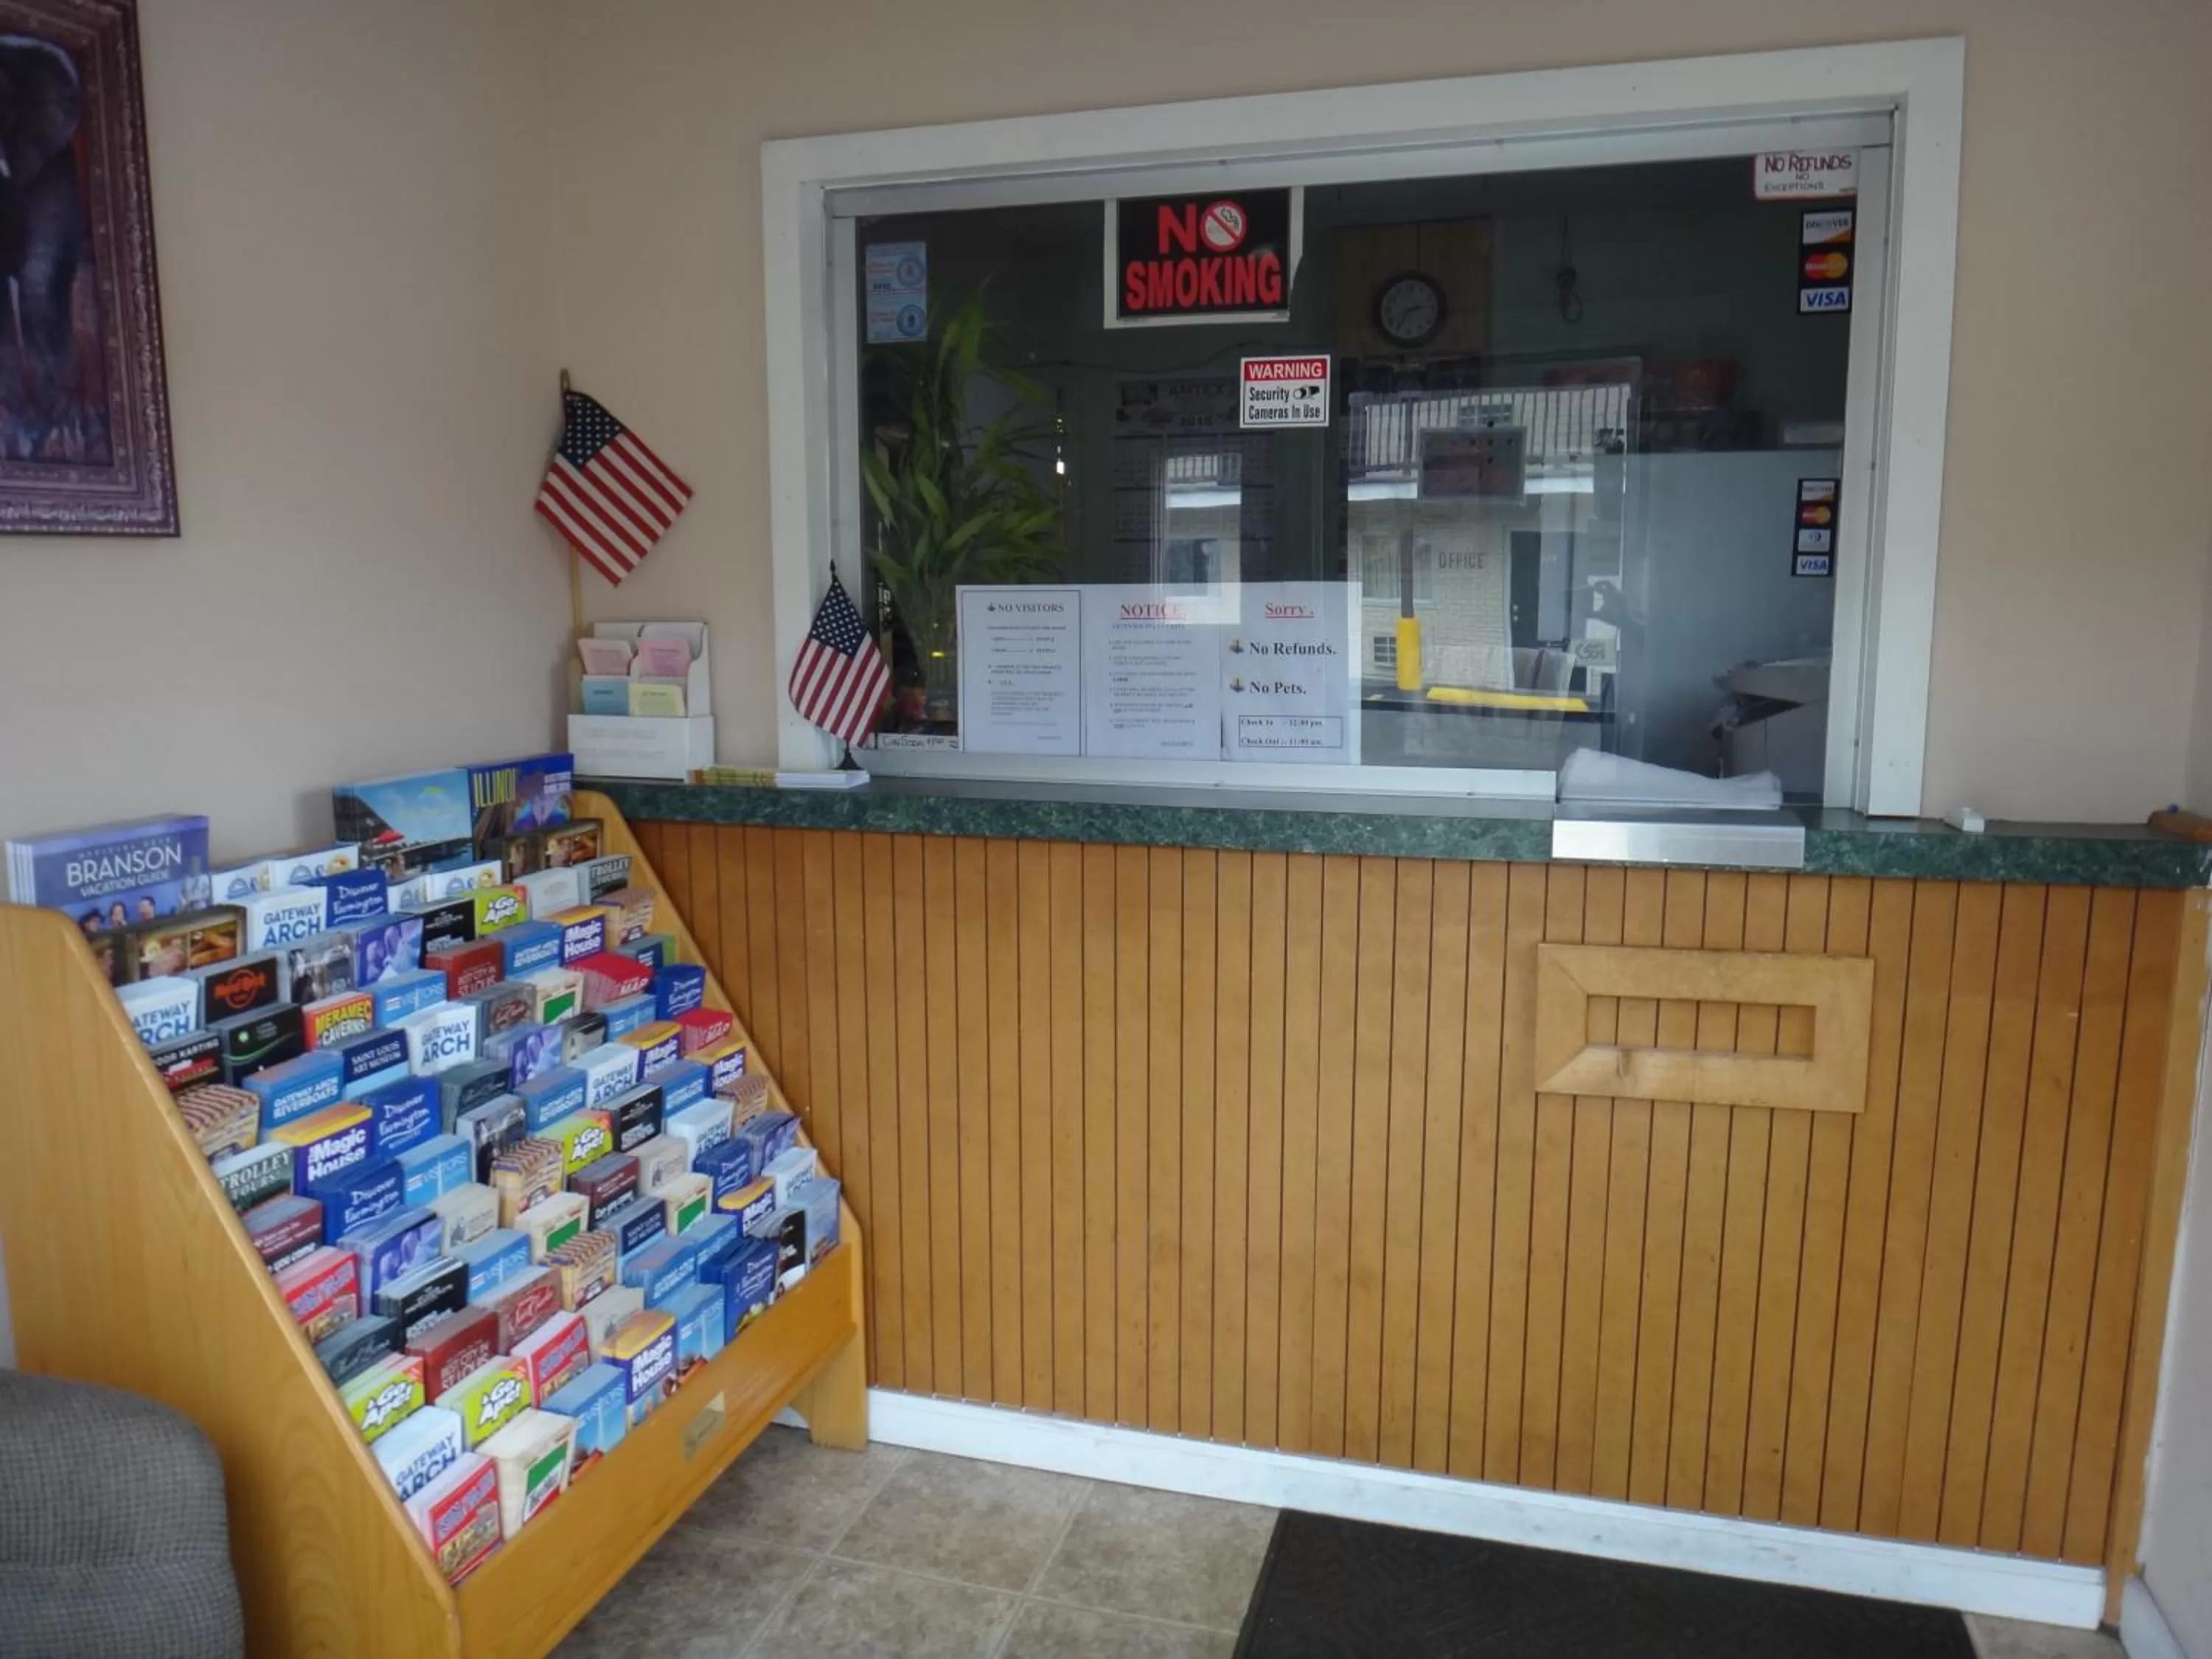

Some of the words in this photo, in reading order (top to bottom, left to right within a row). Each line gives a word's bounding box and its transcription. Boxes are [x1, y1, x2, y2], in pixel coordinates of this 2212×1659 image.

[1765, 155, 1785, 173] NO
[1125, 251, 1282, 310] SMOKING
[1806, 291, 1847, 307] VISA
[1248, 362, 1323, 379] WARNING
[1249, 386, 1290, 403] Security
[1248, 405, 1289, 420] Cameras
[1303, 403, 1321, 418] Use
[1800, 559, 1827, 570] VISA
[1015, 602, 1065, 613] VISITORS
[1249, 641, 1268, 655] No
[1273, 641, 1338, 655] Refunds.
[1250, 681, 1269, 695] No
[66, 842, 183, 888] BRANSON
[80, 875, 136, 897] VACATION
[263, 902, 321, 926] GATEWAY
[263, 917, 321, 947] ARCH
[566, 920, 602, 943] Magic
[564, 934, 602, 959] House
[133, 1000, 192, 1028] ATEWAY
[139, 1015, 191, 1046] RCH
[422, 1018, 470, 1045] GATEWAY
[422, 1033, 470, 1065] ARCH
[311, 1128, 366, 1162] Magic
[307, 1146, 366, 1182] House
[632, 1334, 673, 1370] Magic
[632, 1351, 673, 1392] House
[396, 1431, 456, 1486] GATEWAY
[400, 1446, 457, 1502] ARCH
